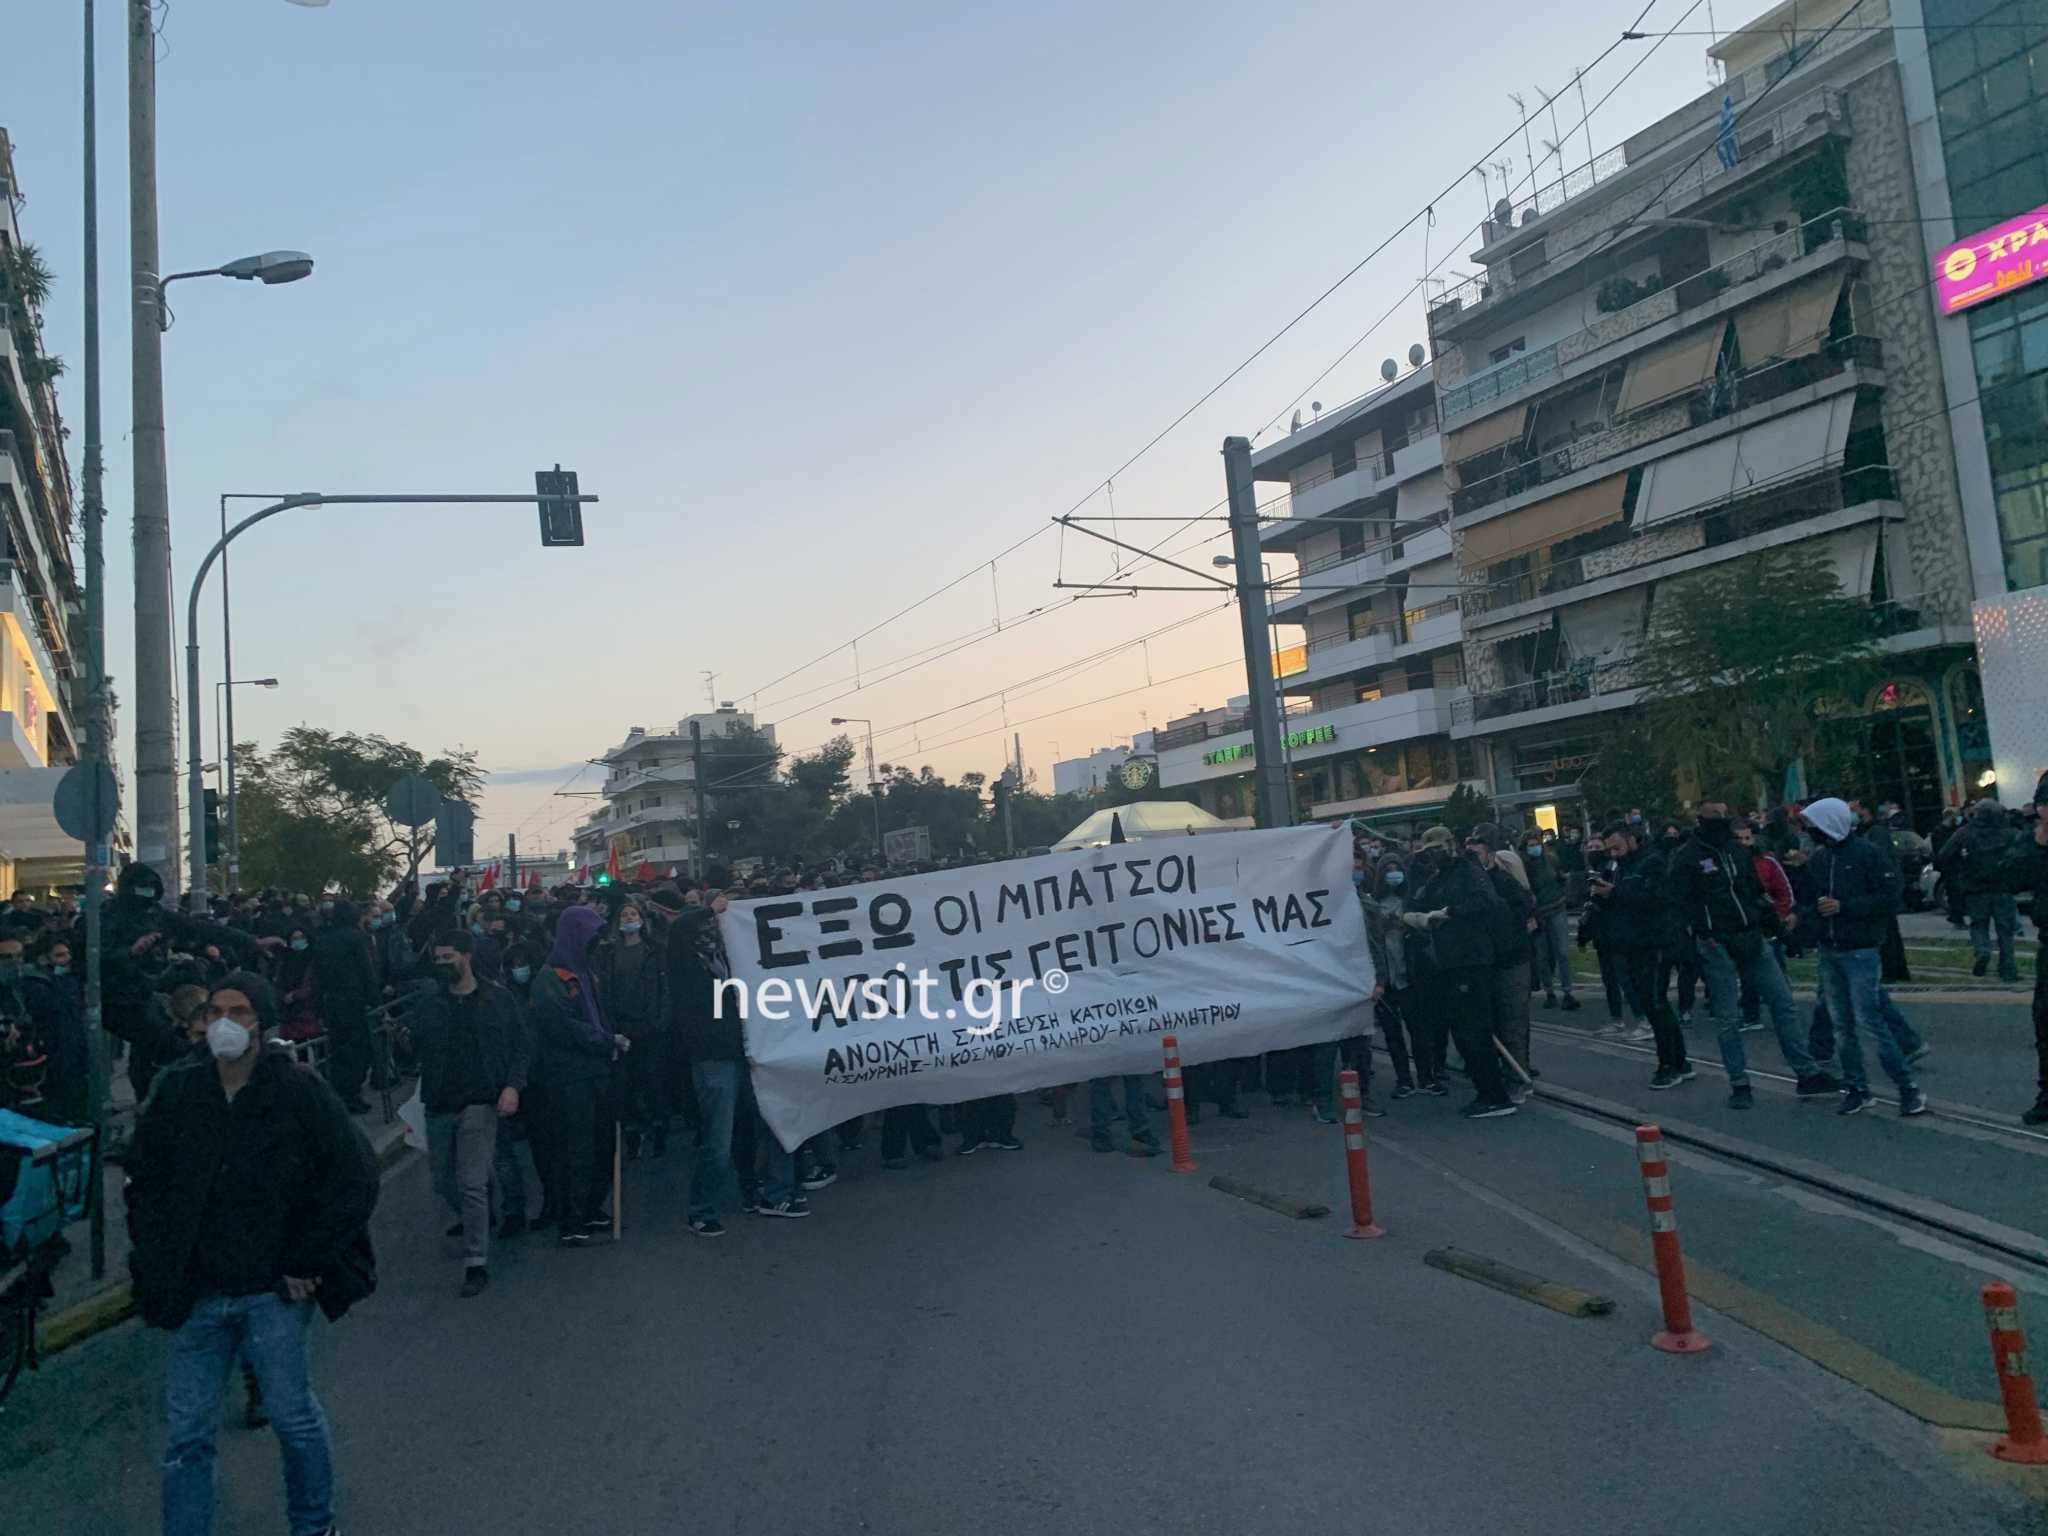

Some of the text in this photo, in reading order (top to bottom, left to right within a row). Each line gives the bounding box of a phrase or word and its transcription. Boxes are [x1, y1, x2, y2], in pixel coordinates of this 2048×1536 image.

[753, 855, 1197, 969] ΕΞΩ ΟΙ ΜΠΑΤΣΟΙ
[939, 950, 1013, 1002] ΤΙΣ
[1028, 902, 1245, 980] ΓΕΙΤΟΝΙΕΣ
[1252, 889, 1332, 932] ΜΑΣ
[824, 1032, 940, 1076] ΑΝΟΙΧΤΗ
[1070, 994, 1159, 1025] ΚΑΤΟΙΚΩΝ
[1149, 1003, 1241, 1033] ΔΗΜΗΤΡΙΟΥ
